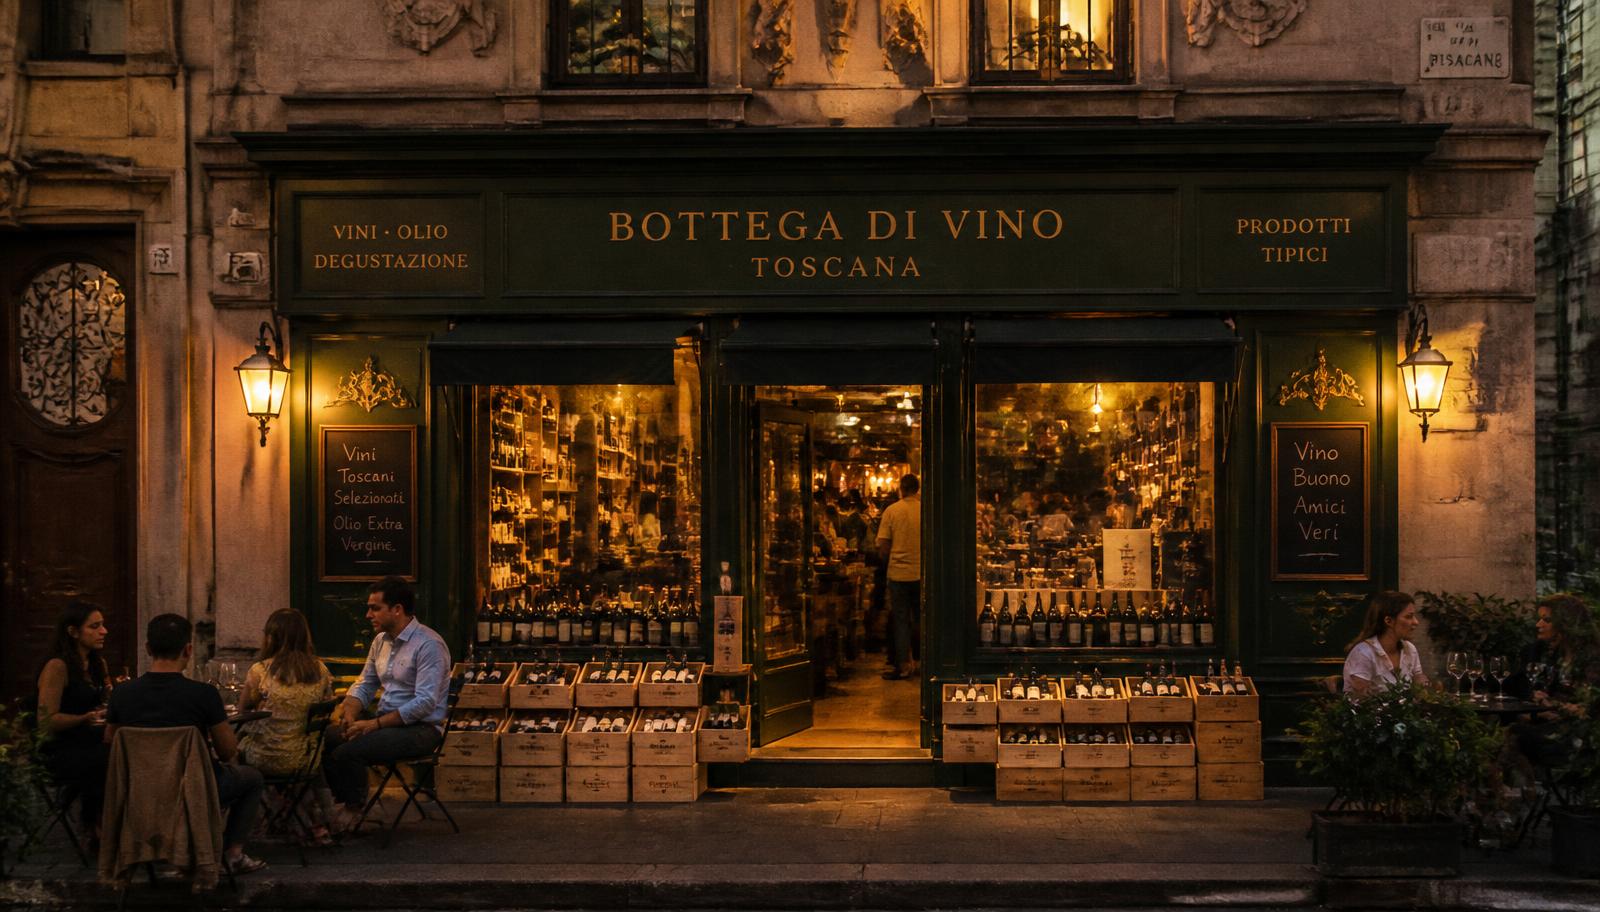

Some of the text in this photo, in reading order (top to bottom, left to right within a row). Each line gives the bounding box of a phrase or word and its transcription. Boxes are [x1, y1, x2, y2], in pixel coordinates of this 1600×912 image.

[333, 224, 448, 240] VINI OLIO
[609, 209, 1063, 241] BOTTEGA DI VINO
[1237, 217, 1352, 234] PRODOTTI
[314, 253, 469, 269] DEGUSTAZIONE
[1261, 247, 1329, 263] TIPICI
[752, 255, 921, 277] TOSCANA
[342, 443, 377, 461] Vini
[1293, 441, 1339, 461] Vino
[337, 467, 395, 484] Toscani
[1292, 467, 1351, 487] Buono
[1292, 495, 1347, 515] Amici
[333, 515, 404, 531] Olio Extra
[1297, 521, 1339, 541] Veri
